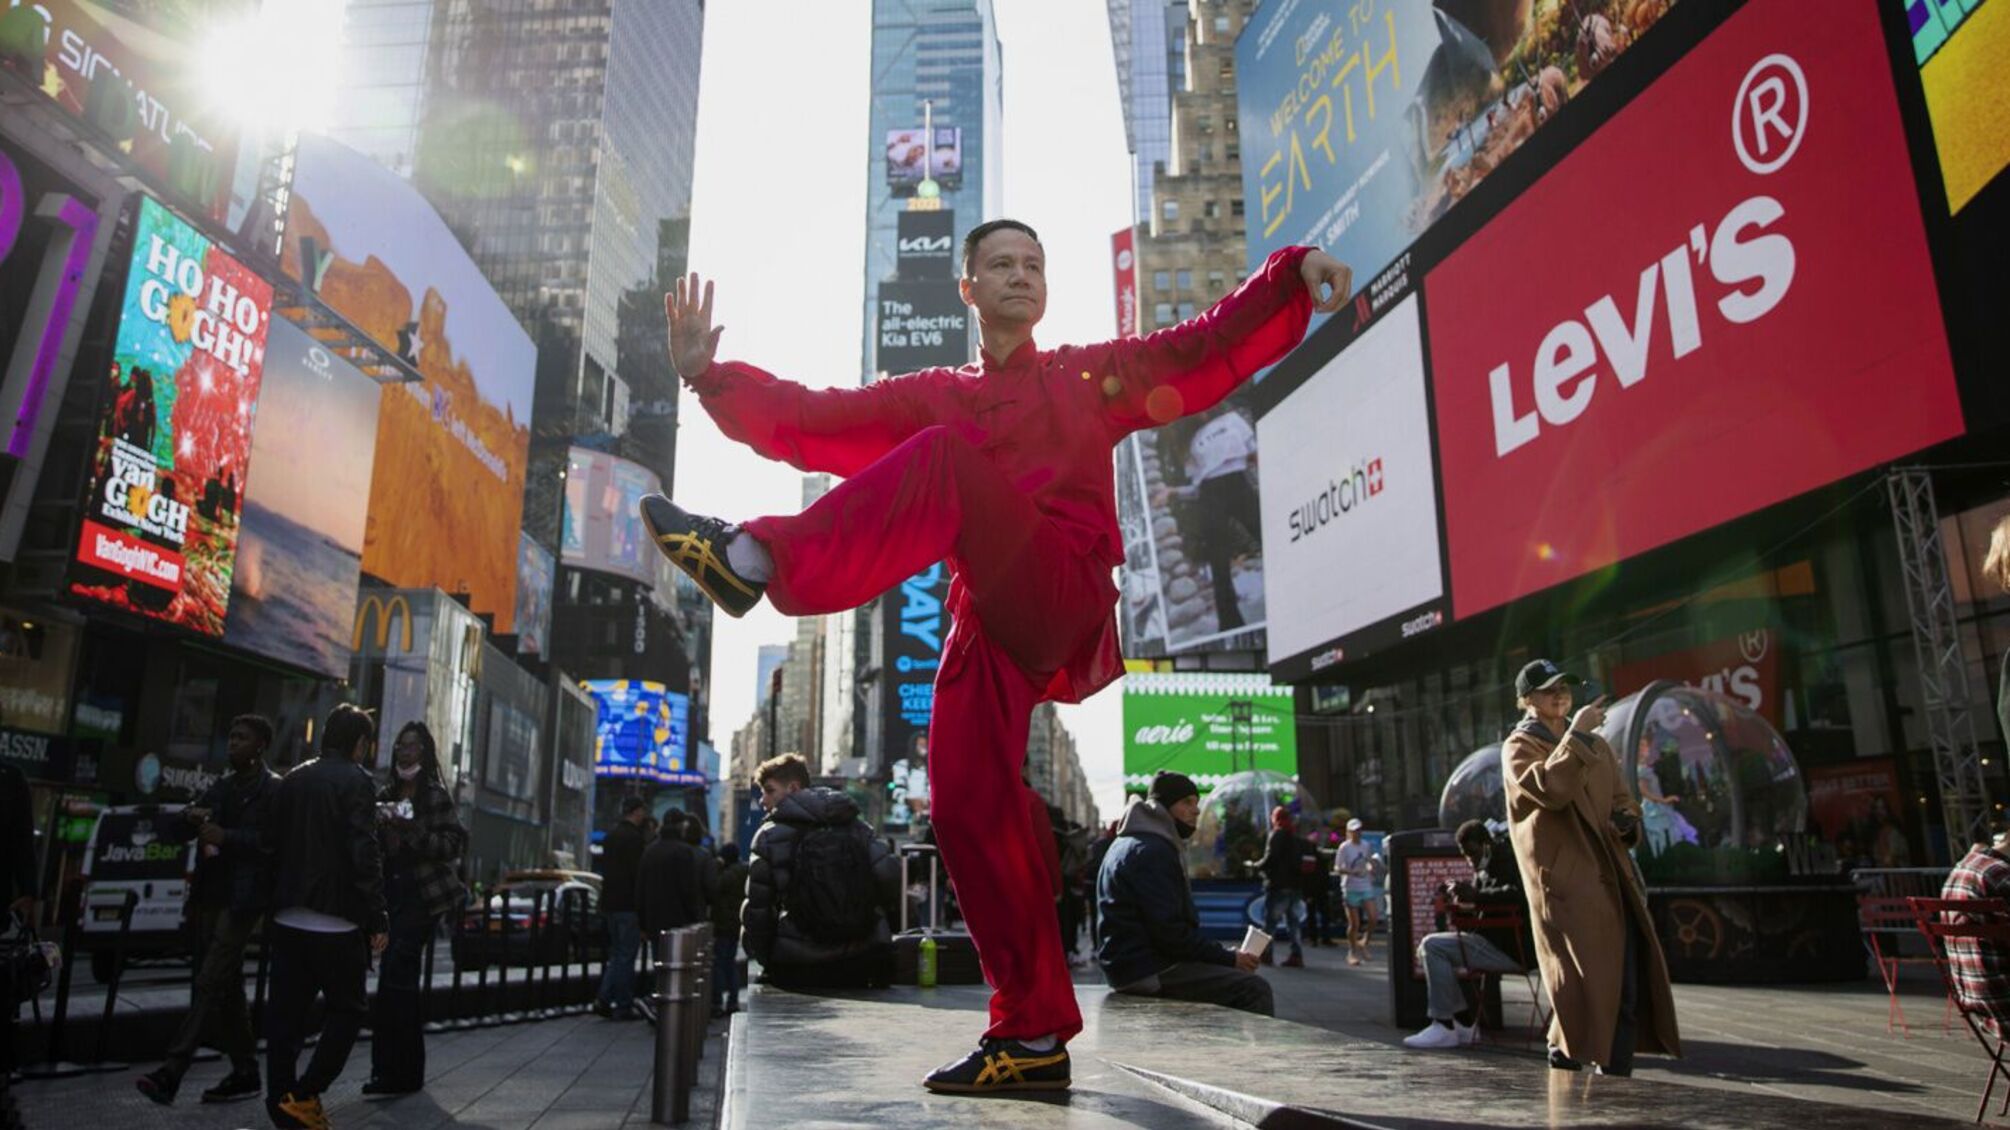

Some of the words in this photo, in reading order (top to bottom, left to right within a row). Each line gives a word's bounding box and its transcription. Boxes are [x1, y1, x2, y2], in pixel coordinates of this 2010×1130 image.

[1270, 27, 1344, 138] WELCOME
[1348, 0, 1374, 37] TO
[1258, 8, 1402, 239] EARTH
[145, 233, 204, 298] HO
[207, 275, 259, 335] HO
[1370, 251, 1411, 297] MARRIOTT
[1372, 272, 1409, 312] MARQUIS
[882, 300, 913, 315] The
[882, 315, 965, 331] all-electric
[882, 332, 907, 348] Kia
[911, 332, 943, 347] EV6
[1288, 464, 1368, 543] swatch
[1402, 613, 1436, 638] swatch
[1310, 650, 1337, 672] swatch
[898, 683, 934, 698] CHIE
[1134, 718, 1195, 745] aerie
[100, 842, 183, 862] JavaBar
